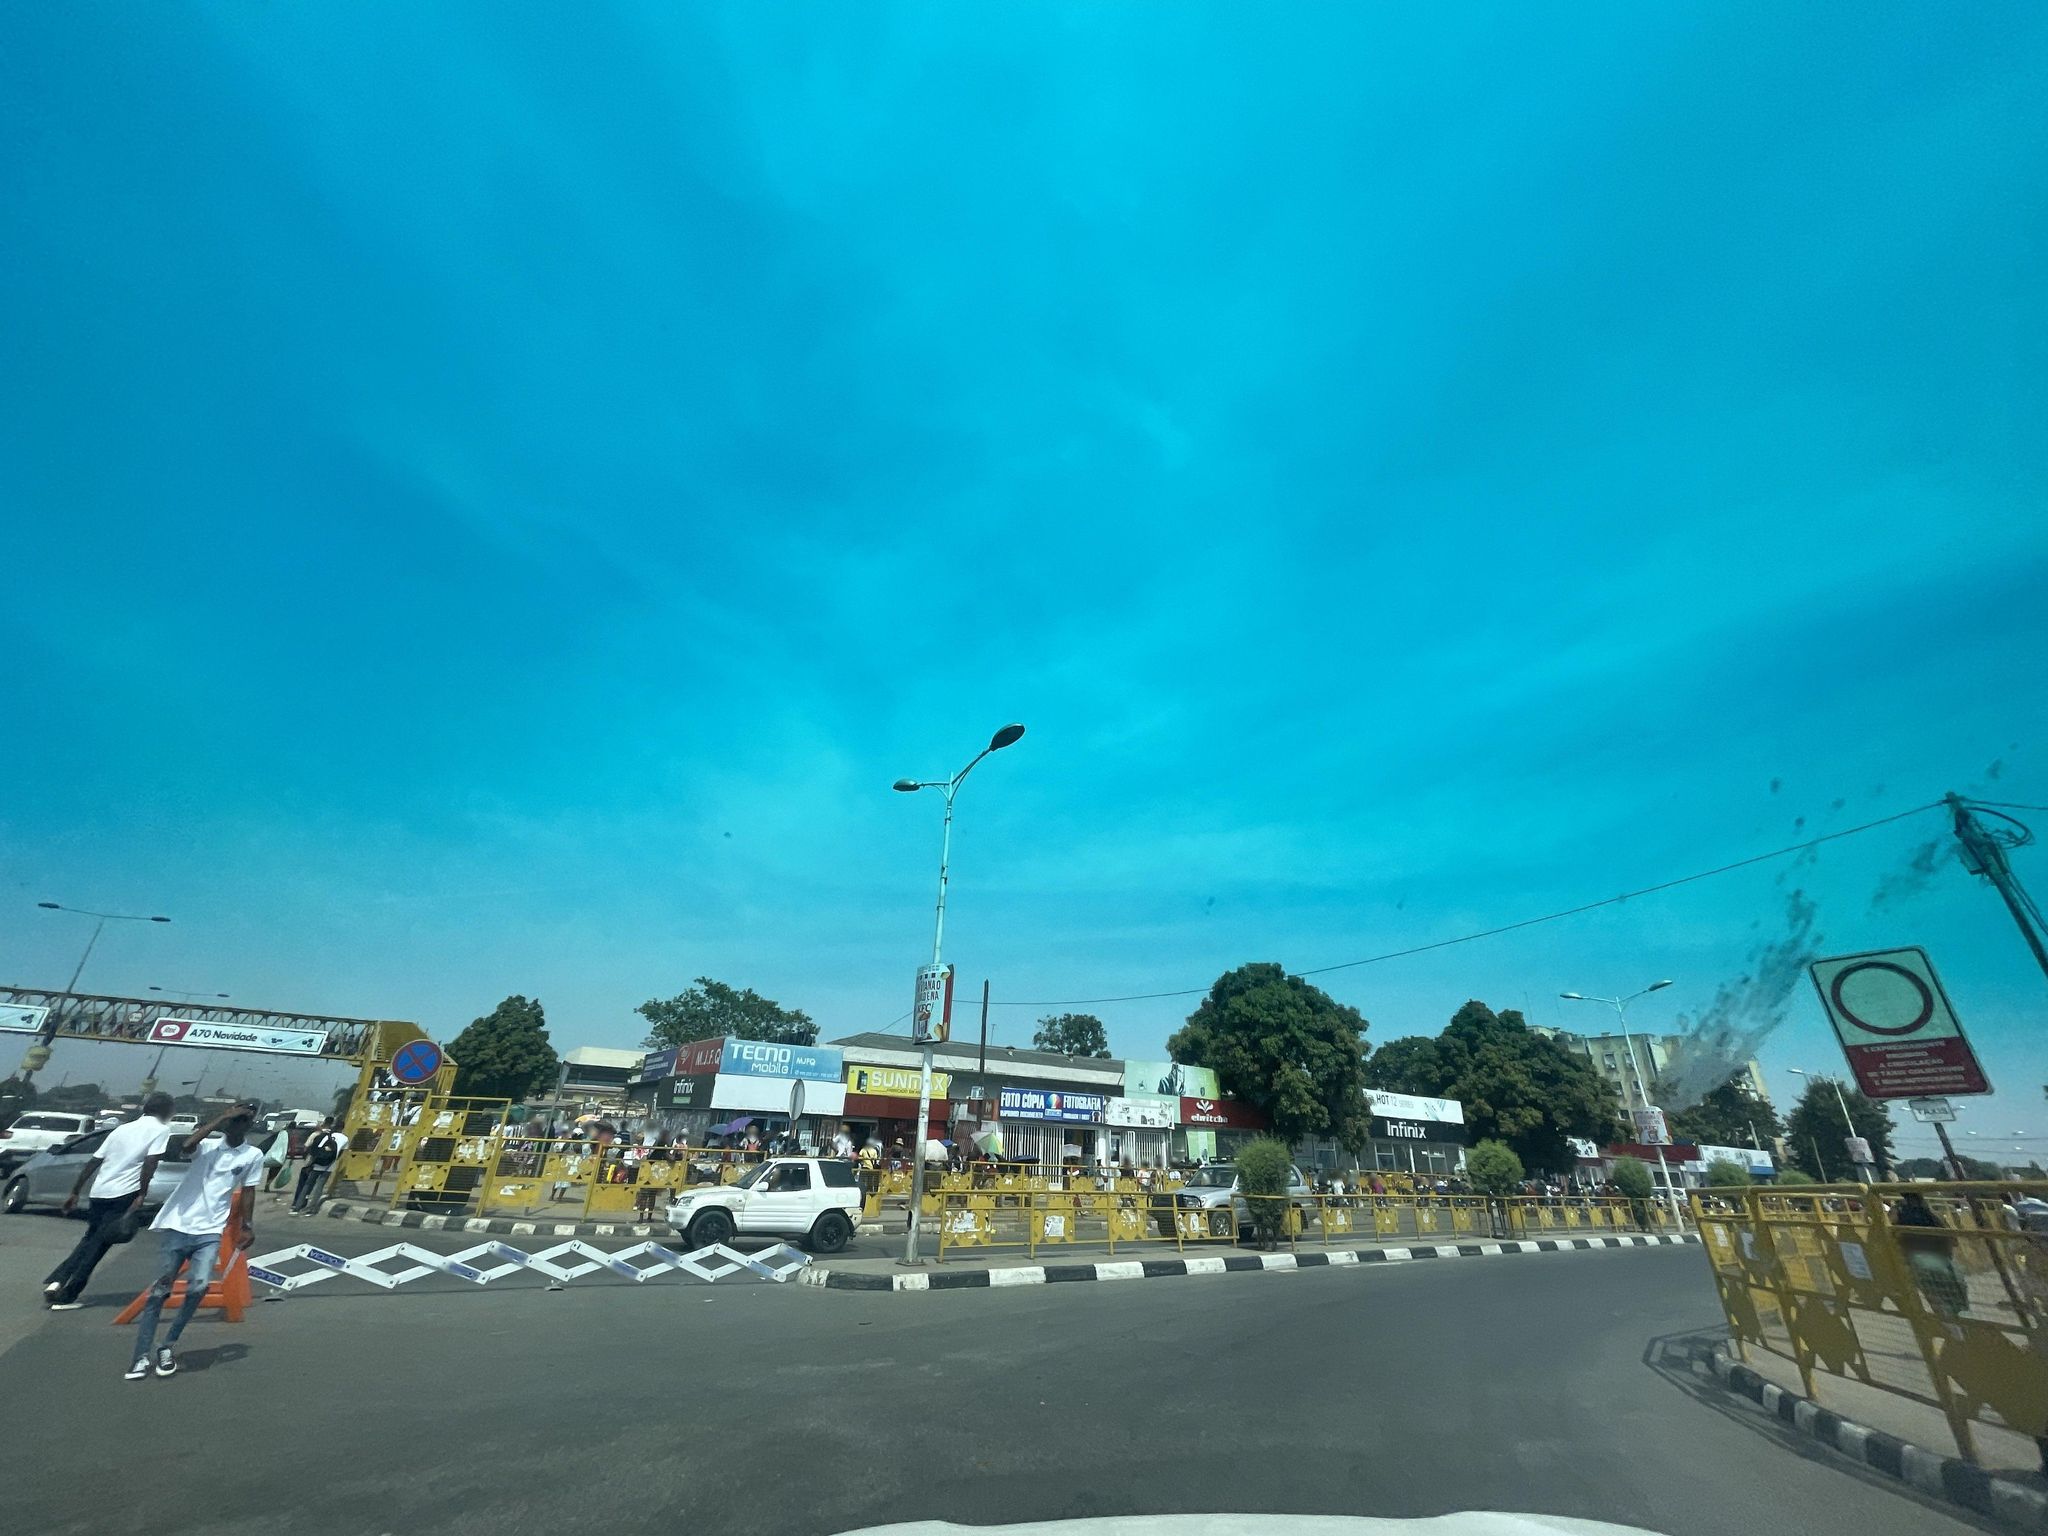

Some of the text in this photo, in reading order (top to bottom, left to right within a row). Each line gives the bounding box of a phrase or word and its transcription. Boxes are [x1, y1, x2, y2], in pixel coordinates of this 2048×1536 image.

[189, 1028, 212, 1038] A70
[213, 1030, 258, 1042] Novidade
[730, 1043, 792, 1063] TECNO
[796, 1057, 816, 1066] MJFQ
[1001, 1092, 1021, 1107] FOTO
[1022, 1091, 1045, 1109] CÓPIA
[1063, 1095, 1101, 1111] FOTOGRAFIA
[1376, 1094, 1389, 1105] HOT
[1386, 1119, 1427, 1139] Infinix
